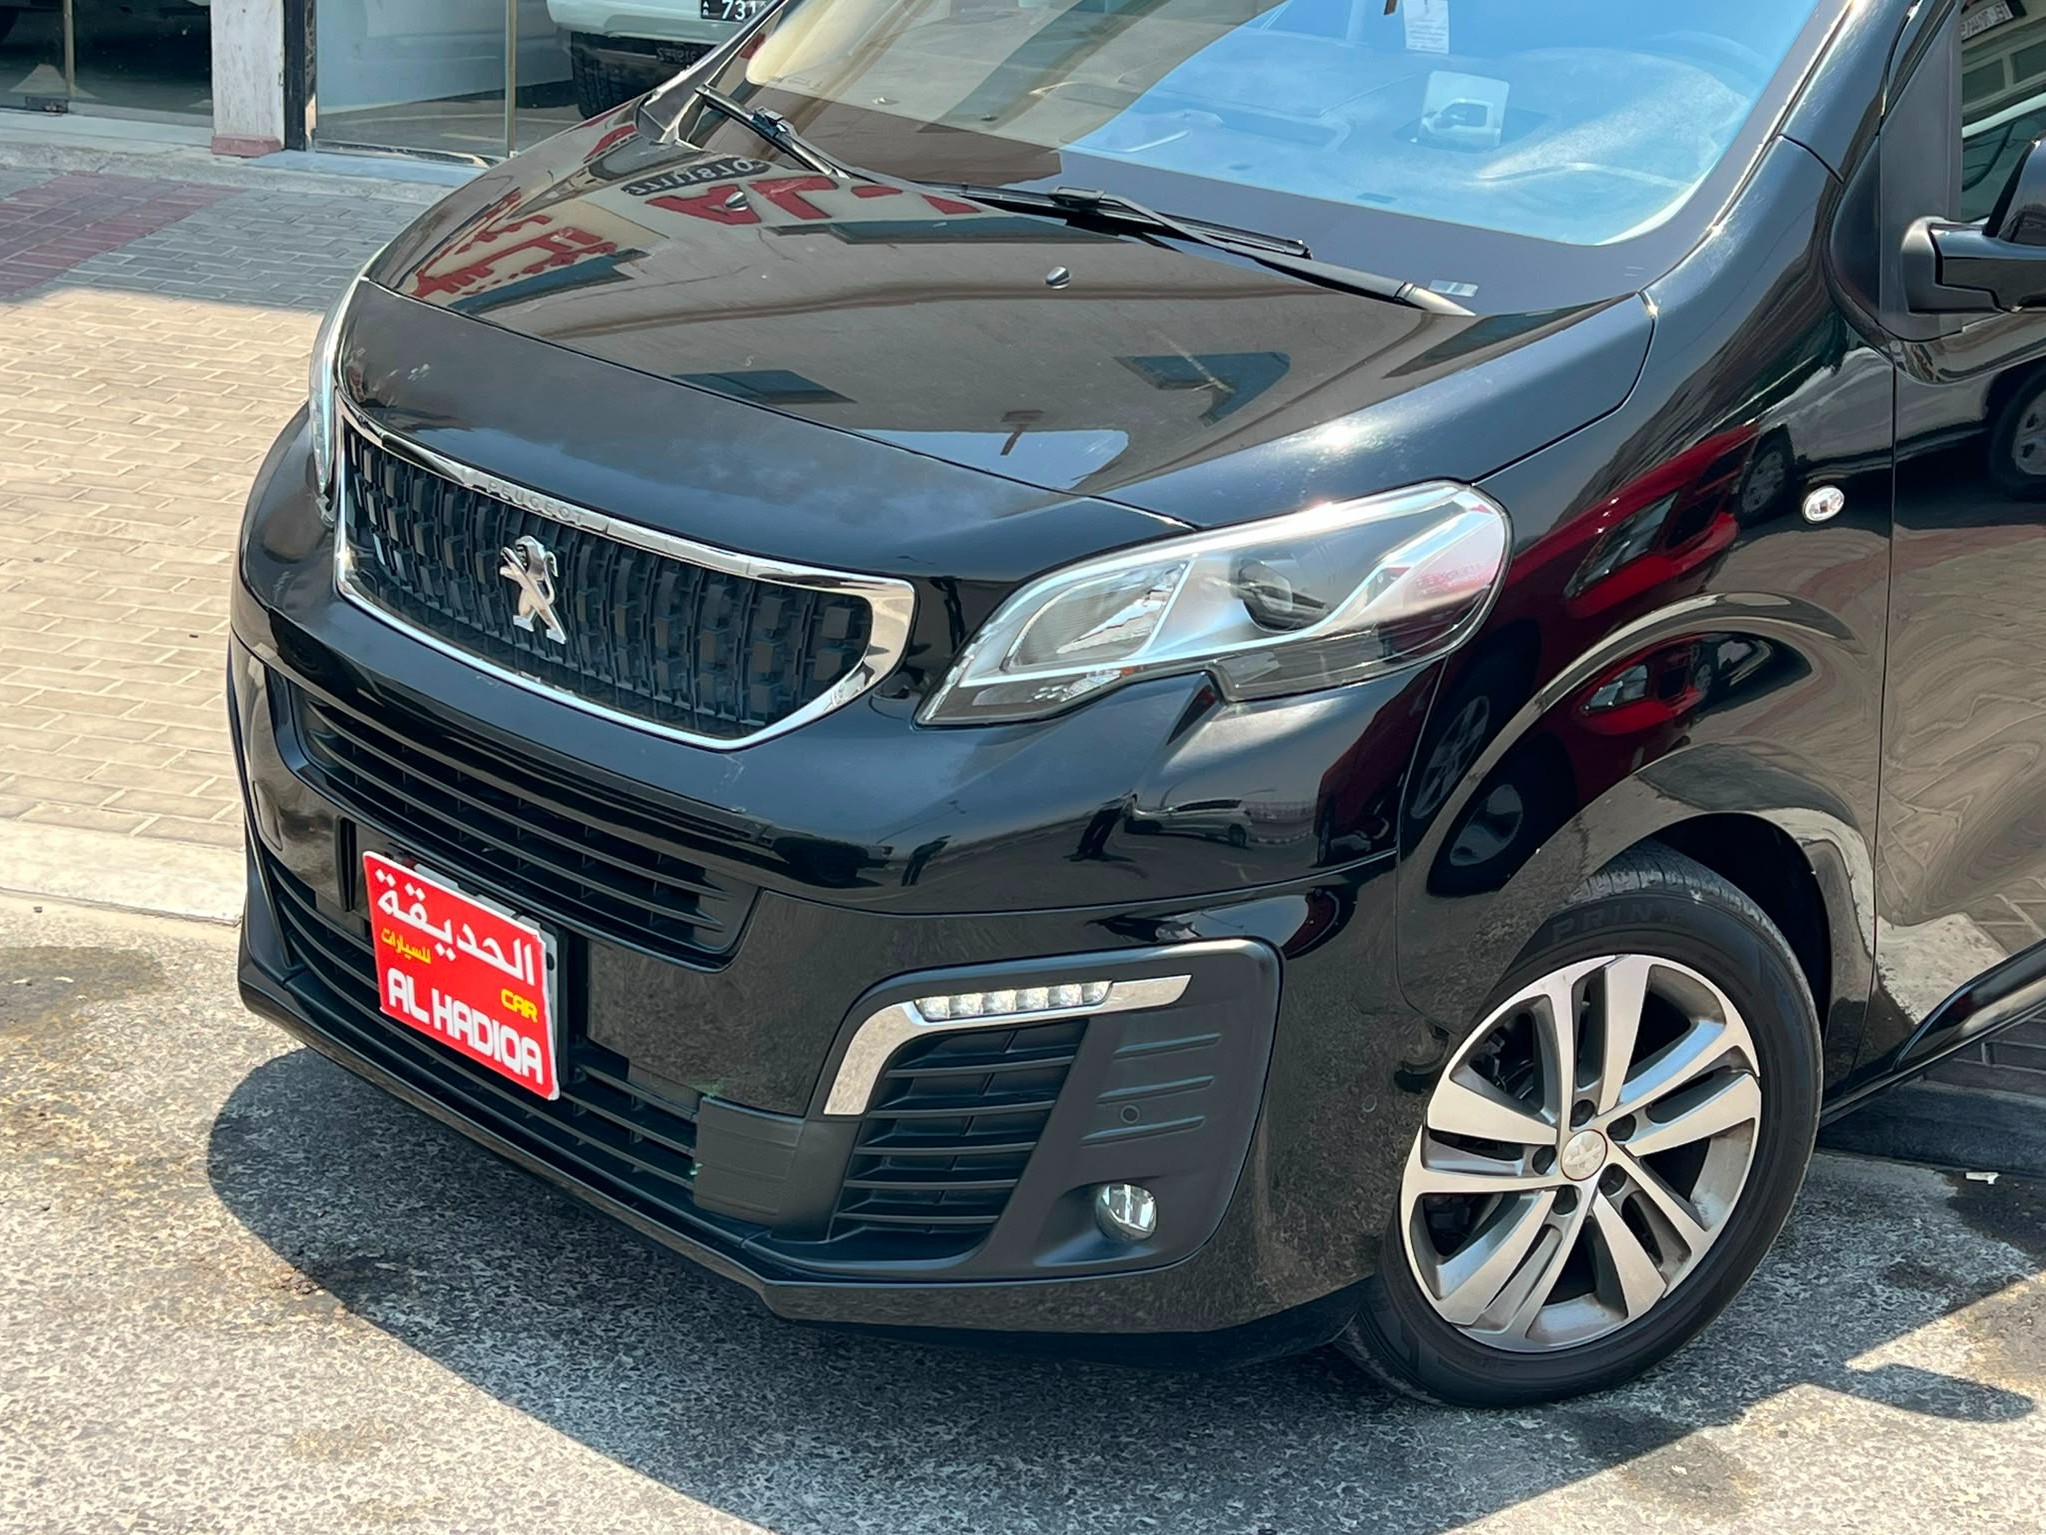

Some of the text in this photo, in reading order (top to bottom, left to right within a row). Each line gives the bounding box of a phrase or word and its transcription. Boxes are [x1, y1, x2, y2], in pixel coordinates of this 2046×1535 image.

[721, 0, 764, 21] 731
[375, 868, 536, 987] الحديقة
[387, 967, 544, 1086] AL HADIQA
[500, 988, 539, 1023] CAR
